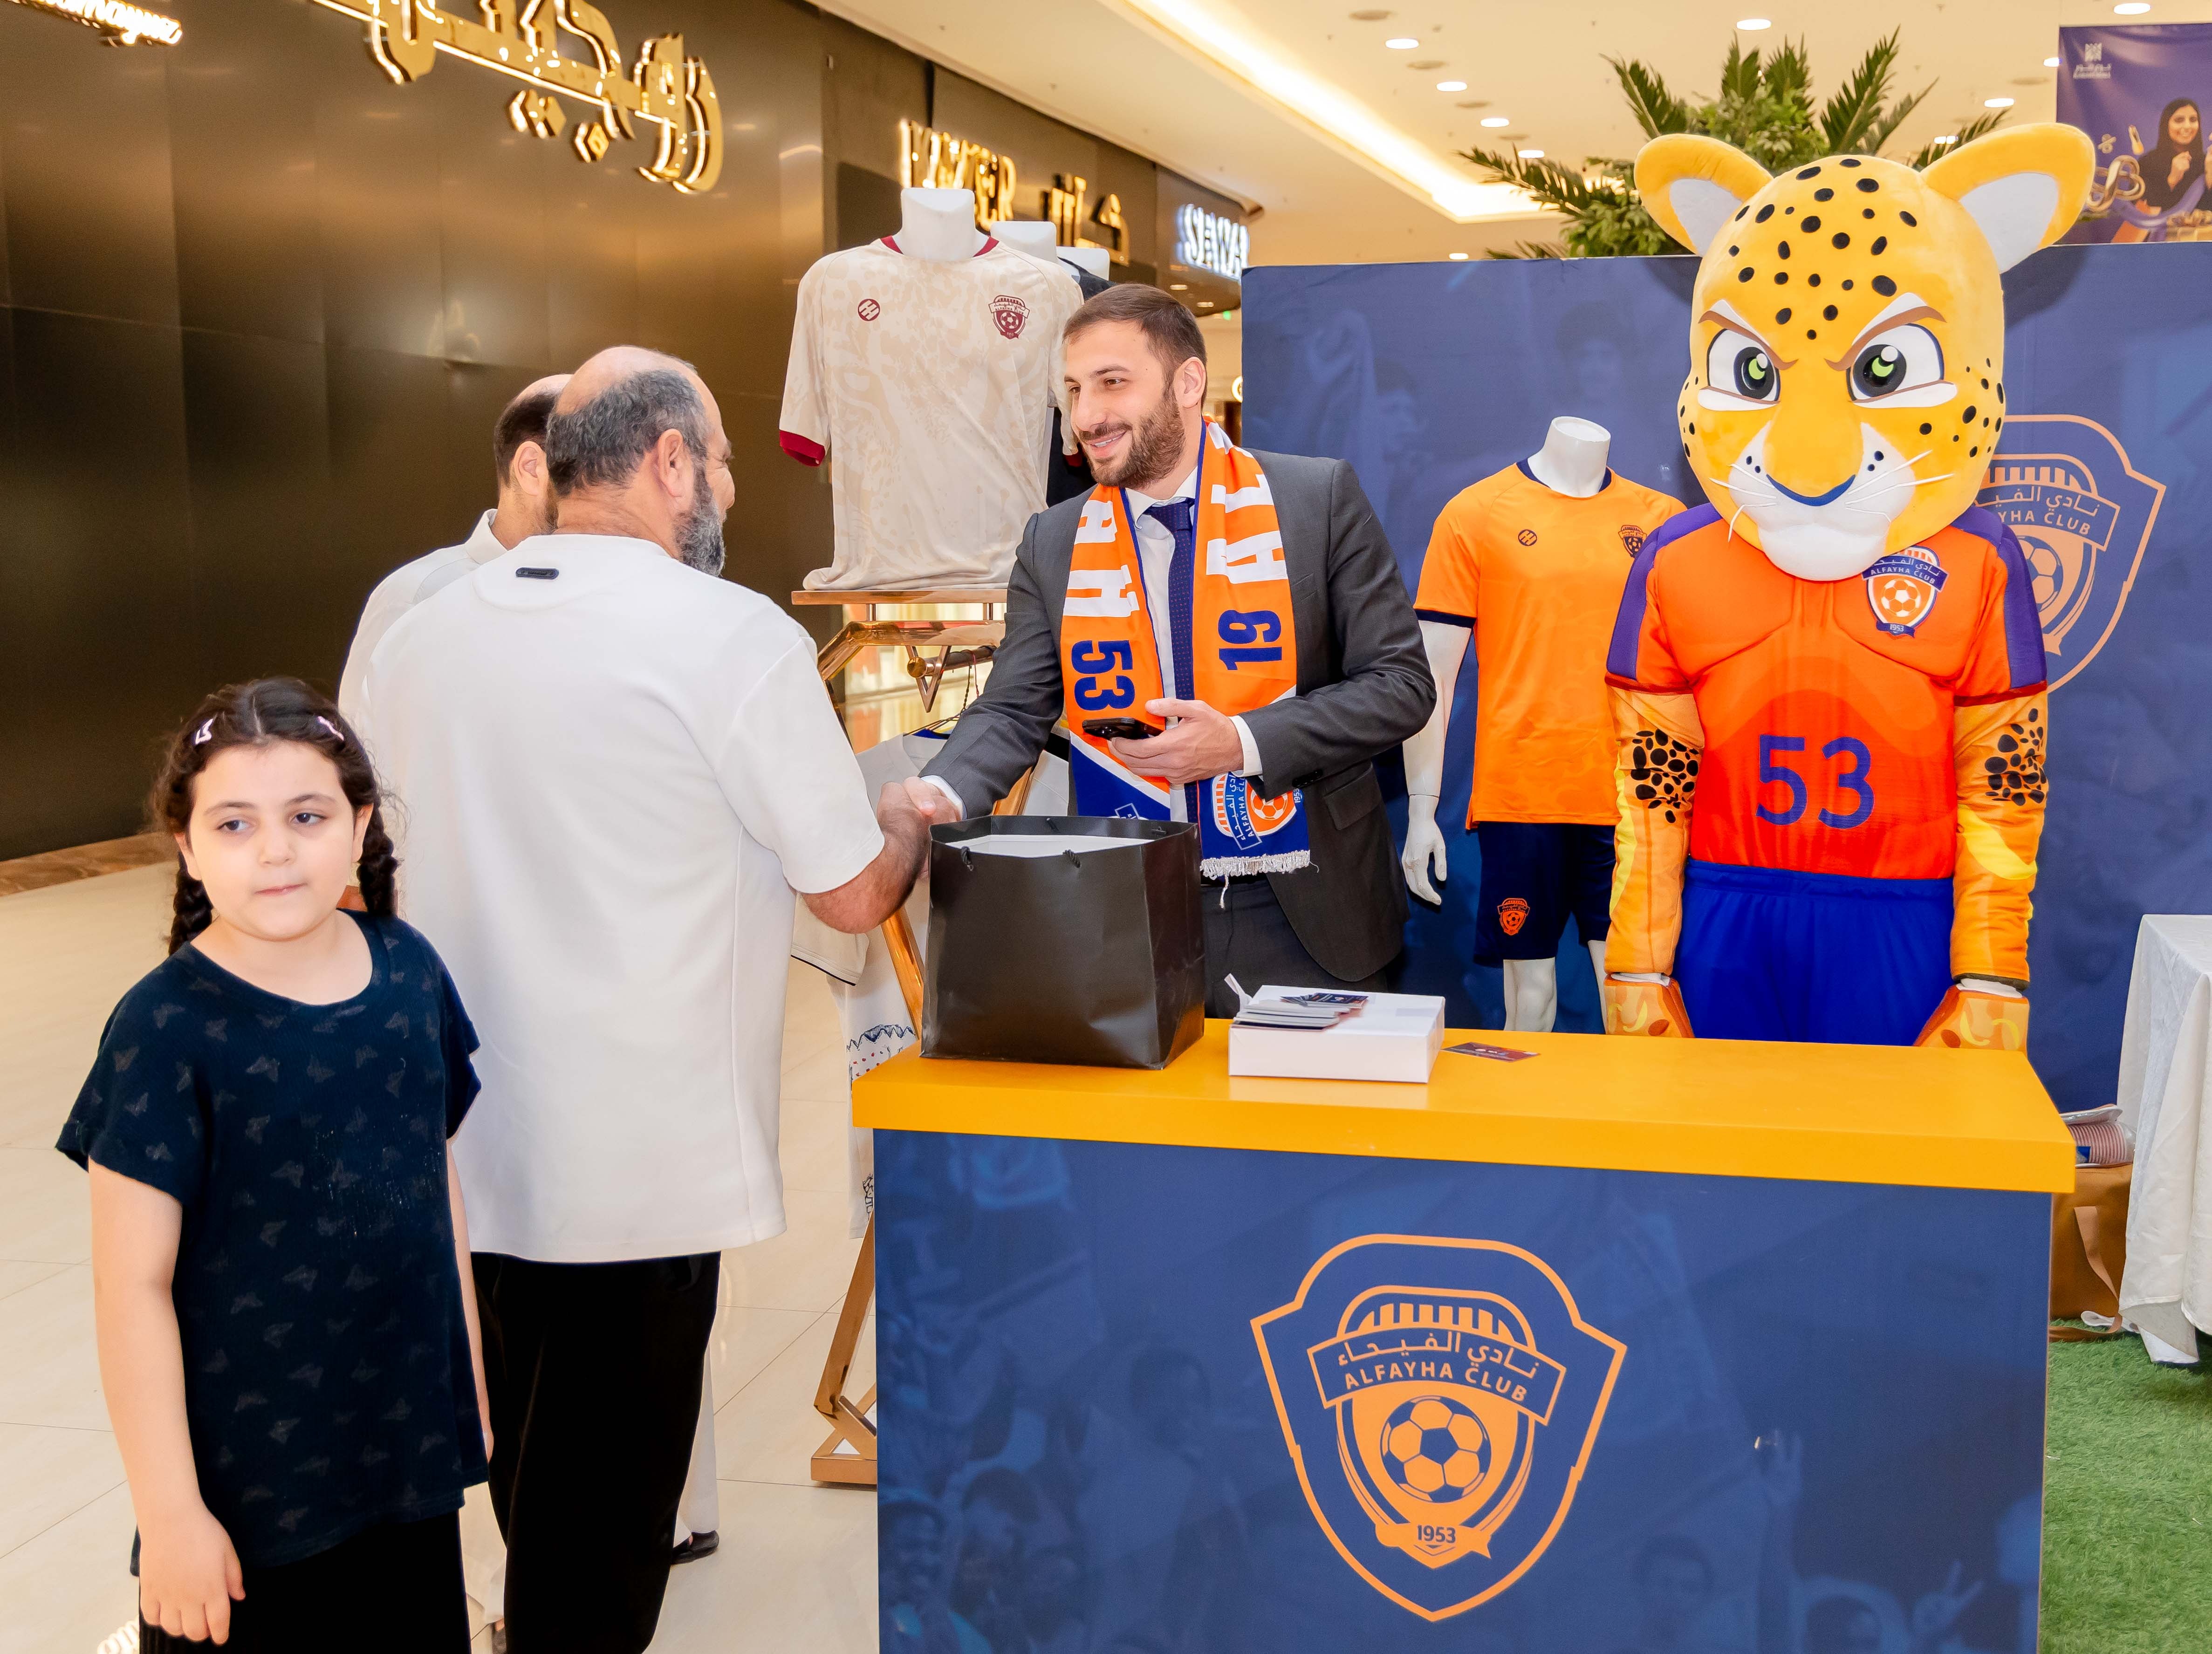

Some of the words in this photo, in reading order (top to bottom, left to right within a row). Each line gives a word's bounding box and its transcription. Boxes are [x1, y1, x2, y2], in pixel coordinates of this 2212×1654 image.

[2047, 494, 2100, 517] نادي
[2044, 512, 2091, 536] CLUB
[1870, 566, 1911, 575] ALFAYHA
[1913, 571, 1935, 584] CLUB
[1874, 557, 1914, 566] الفيح
[1915, 563, 1941, 577] نادي
[1218, 609, 1282, 670] 19
[1890, 624, 1904, 632] 1953
[1071, 640, 1136, 711] 53
[1229, 774, 1239, 793] ادي
[1755, 734, 1875, 829] 53
[1226, 794, 1246, 841] الفيحاء
[1238, 795, 1255, 837] ALFAYHA
[1338, 1330, 1461, 1366] الفيحاء
[1467, 1345, 1539, 1379] نادي
[1344, 1361, 1453, 1390] ALFAYHA
[1465, 1367, 1527, 1401] CLUB
[1417, 1524, 1456, 1544] 1953
